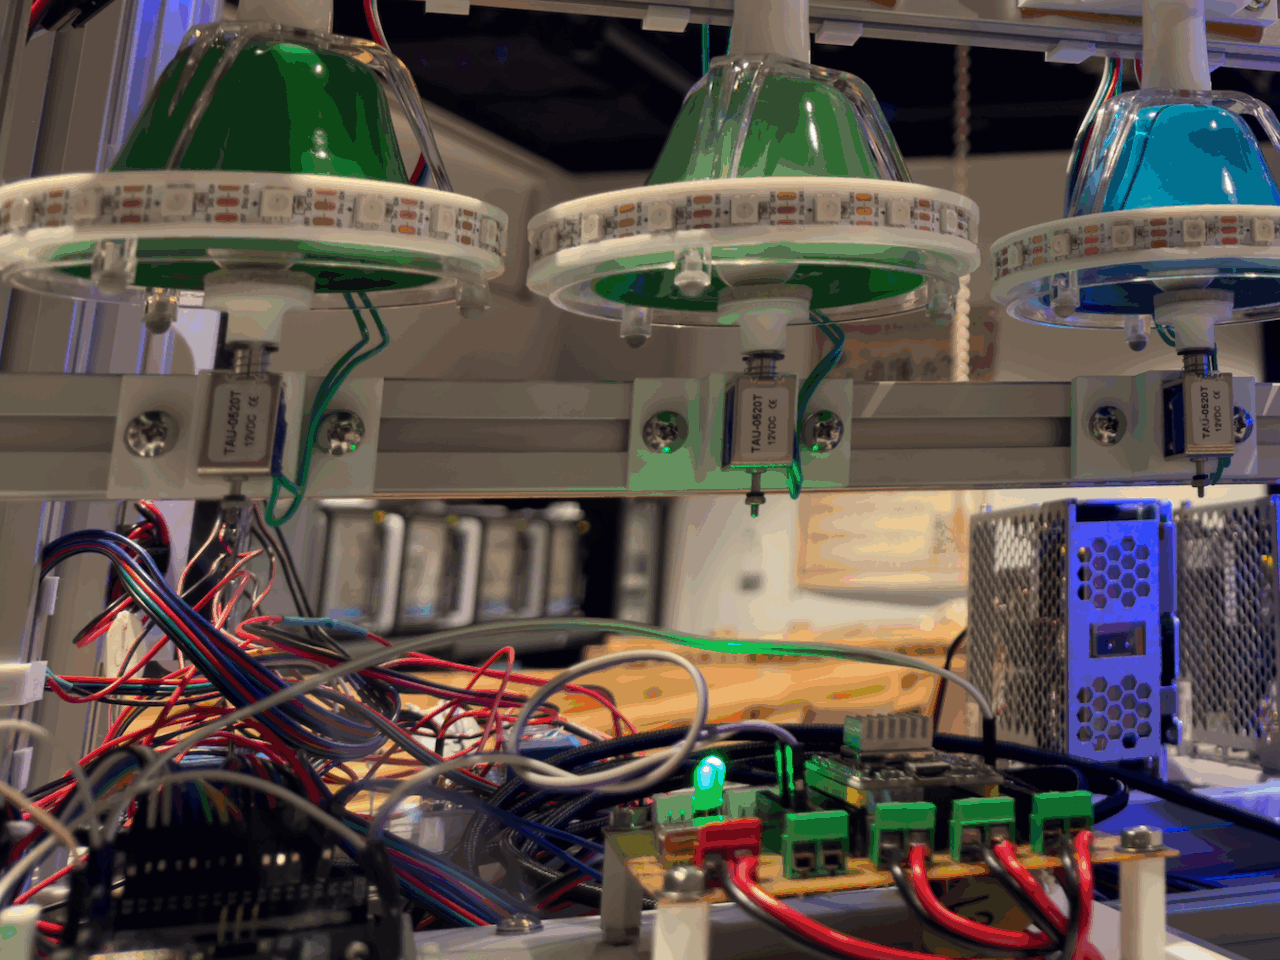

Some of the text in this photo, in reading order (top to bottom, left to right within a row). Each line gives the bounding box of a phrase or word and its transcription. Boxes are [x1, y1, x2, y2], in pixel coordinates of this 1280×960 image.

[223, 390, 242, 456] TAU-0520T
[244, 414, 256, 447] 12VDC
[750, 394, 762, 454] TAU-0520T
[768, 416, 776, 445] 12VDC
[1200, 386, 1210, 439] TAU-0520T
[1214, 405, 1222, 432] 12VDC
